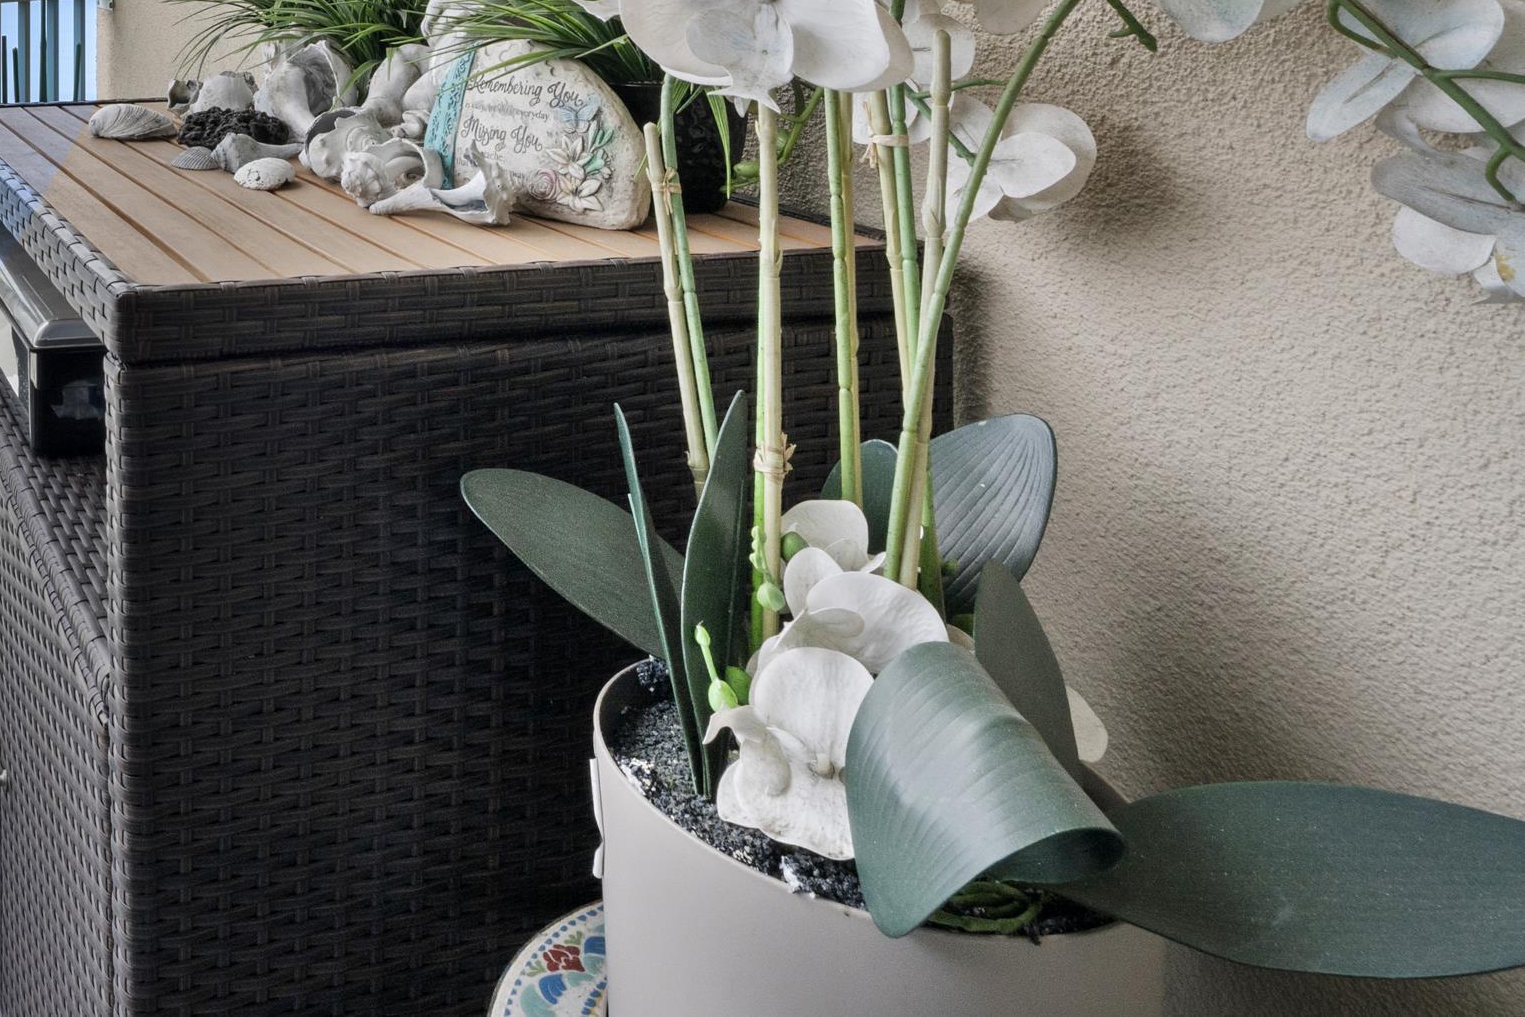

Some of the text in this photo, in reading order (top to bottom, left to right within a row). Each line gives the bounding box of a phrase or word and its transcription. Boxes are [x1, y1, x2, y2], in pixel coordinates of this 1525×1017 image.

[465, 75, 584, 108] Remembering You
[461, 115, 543, 154] Missing You
